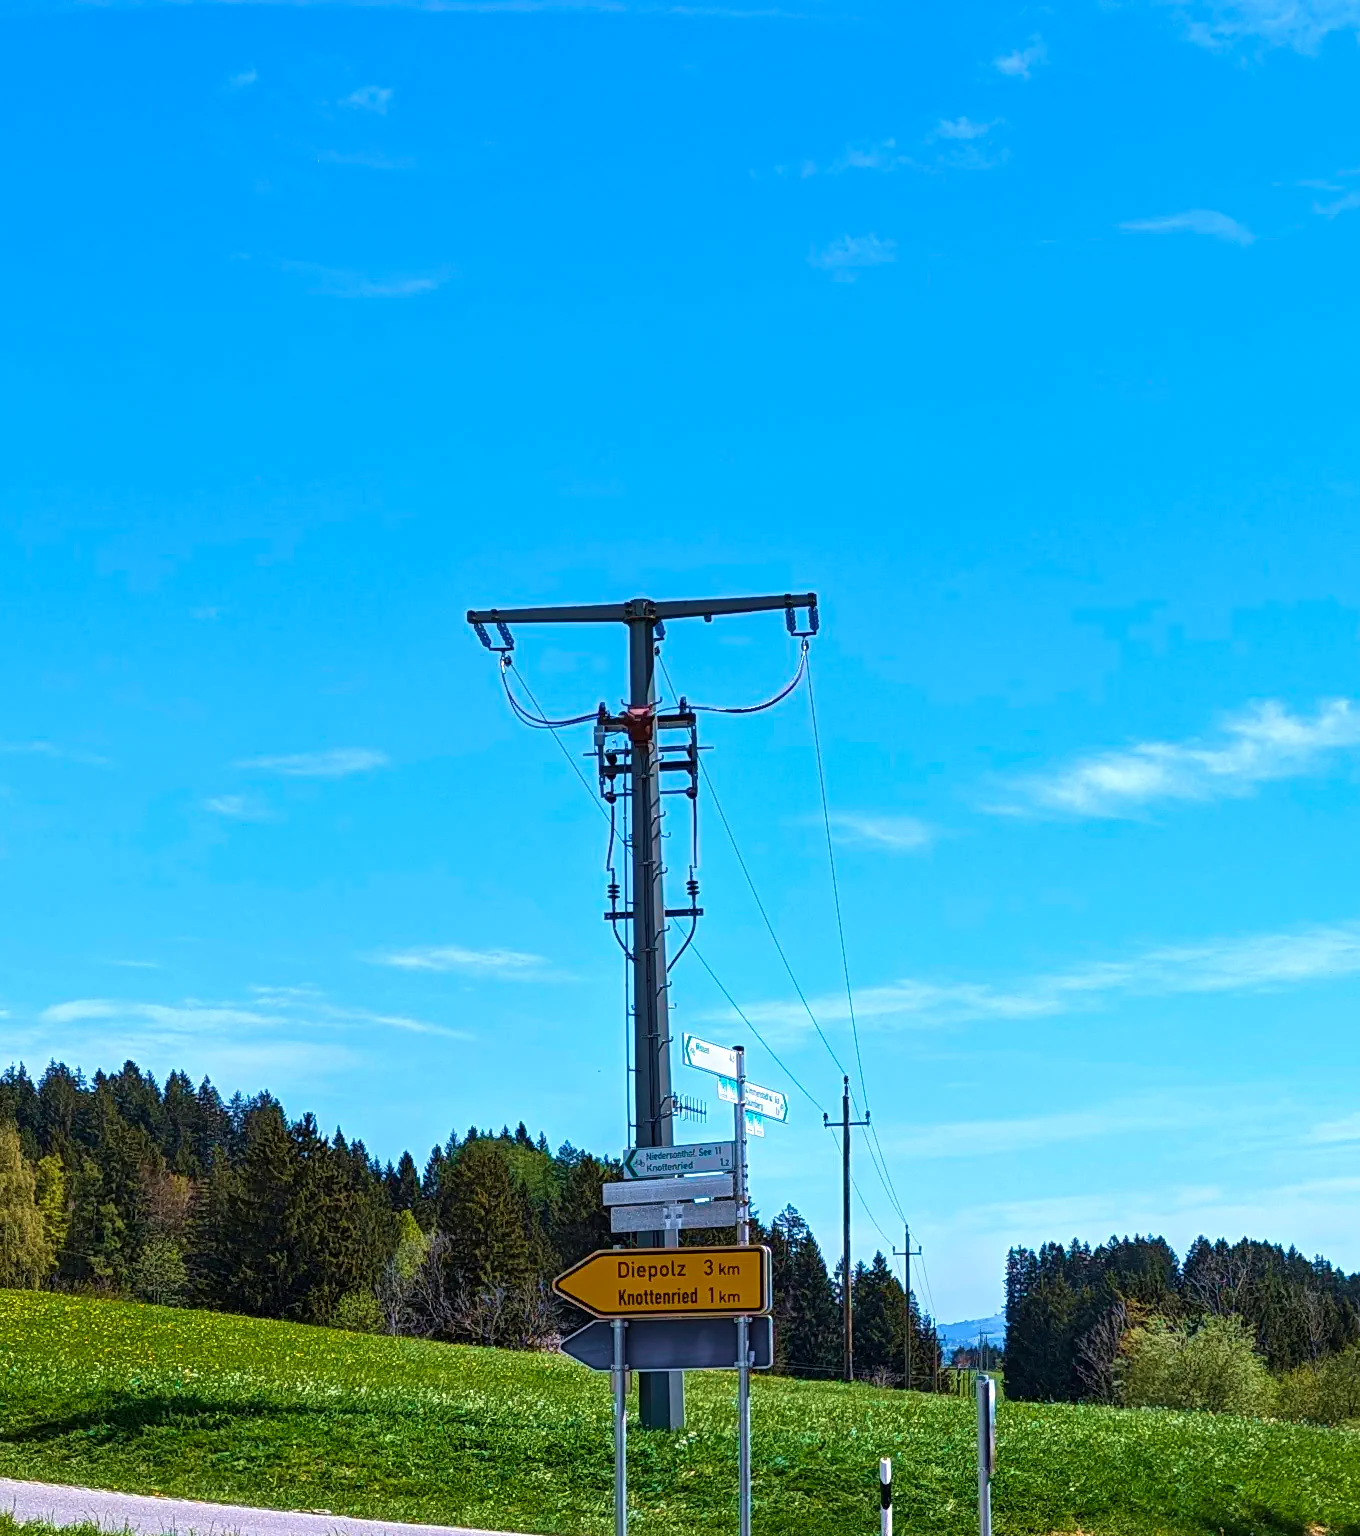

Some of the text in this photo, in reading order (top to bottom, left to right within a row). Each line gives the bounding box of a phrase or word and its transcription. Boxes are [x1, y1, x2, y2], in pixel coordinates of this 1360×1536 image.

[698, 1147, 712, 1157] See
[714, 1146, 722, 1155] 11
[646, 1161, 694, 1172] Knottenried
[617, 1259, 740, 1282] Diepolz 3 km
[618, 1287, 740, 1306] Knottenried 1 km
